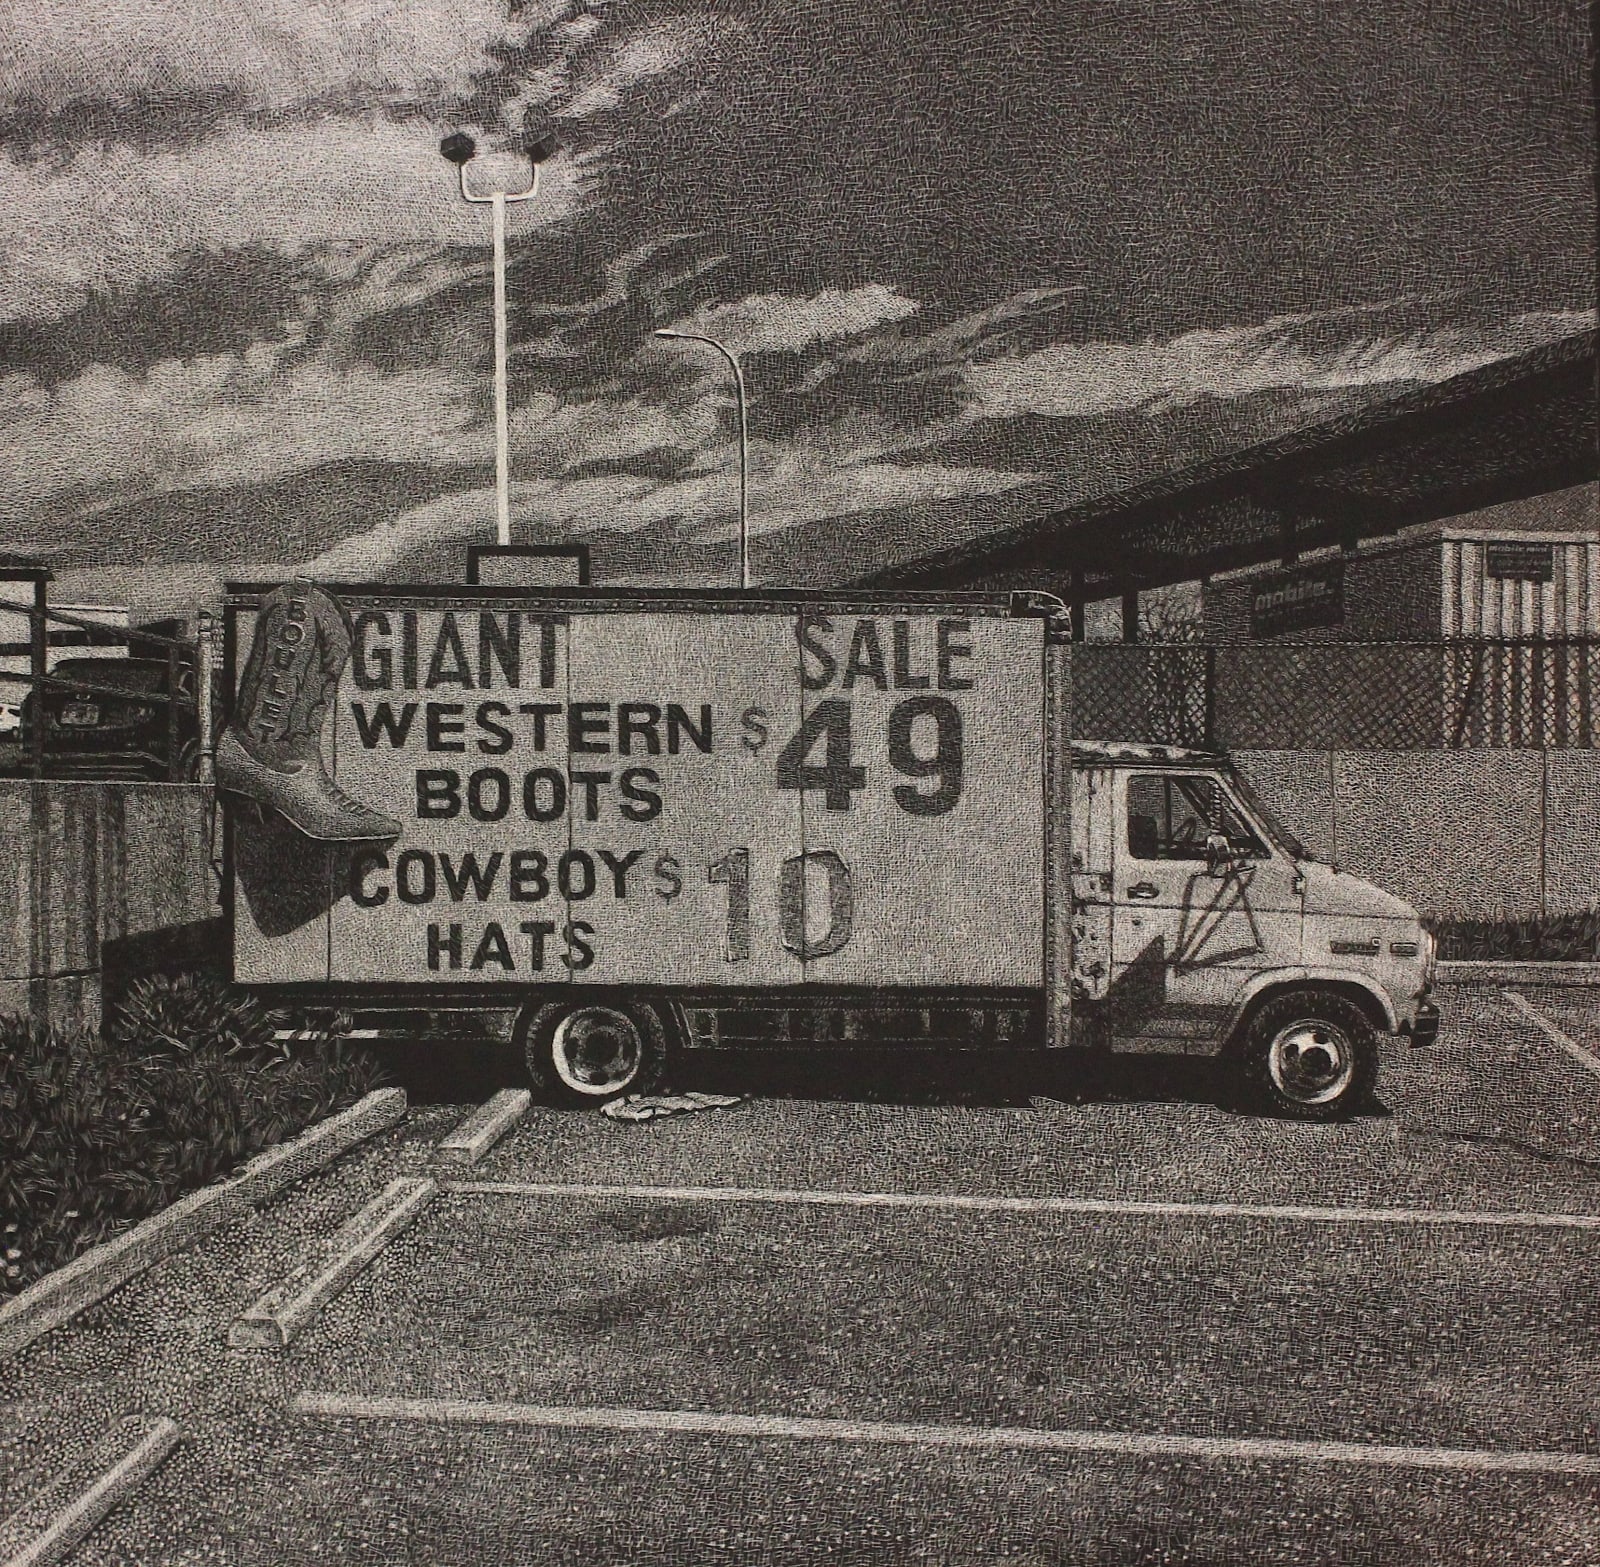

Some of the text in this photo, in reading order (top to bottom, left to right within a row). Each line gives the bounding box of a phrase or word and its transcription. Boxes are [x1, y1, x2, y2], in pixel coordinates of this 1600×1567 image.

[351, 610, 974, 692] GIANT SALE
[351, 701, 712, 755] WESTERN
[415, 767, 663, 822] BOOTS
[349, 847, 645, 908] COWBOY
[426, 920, 596, 972] HATS
